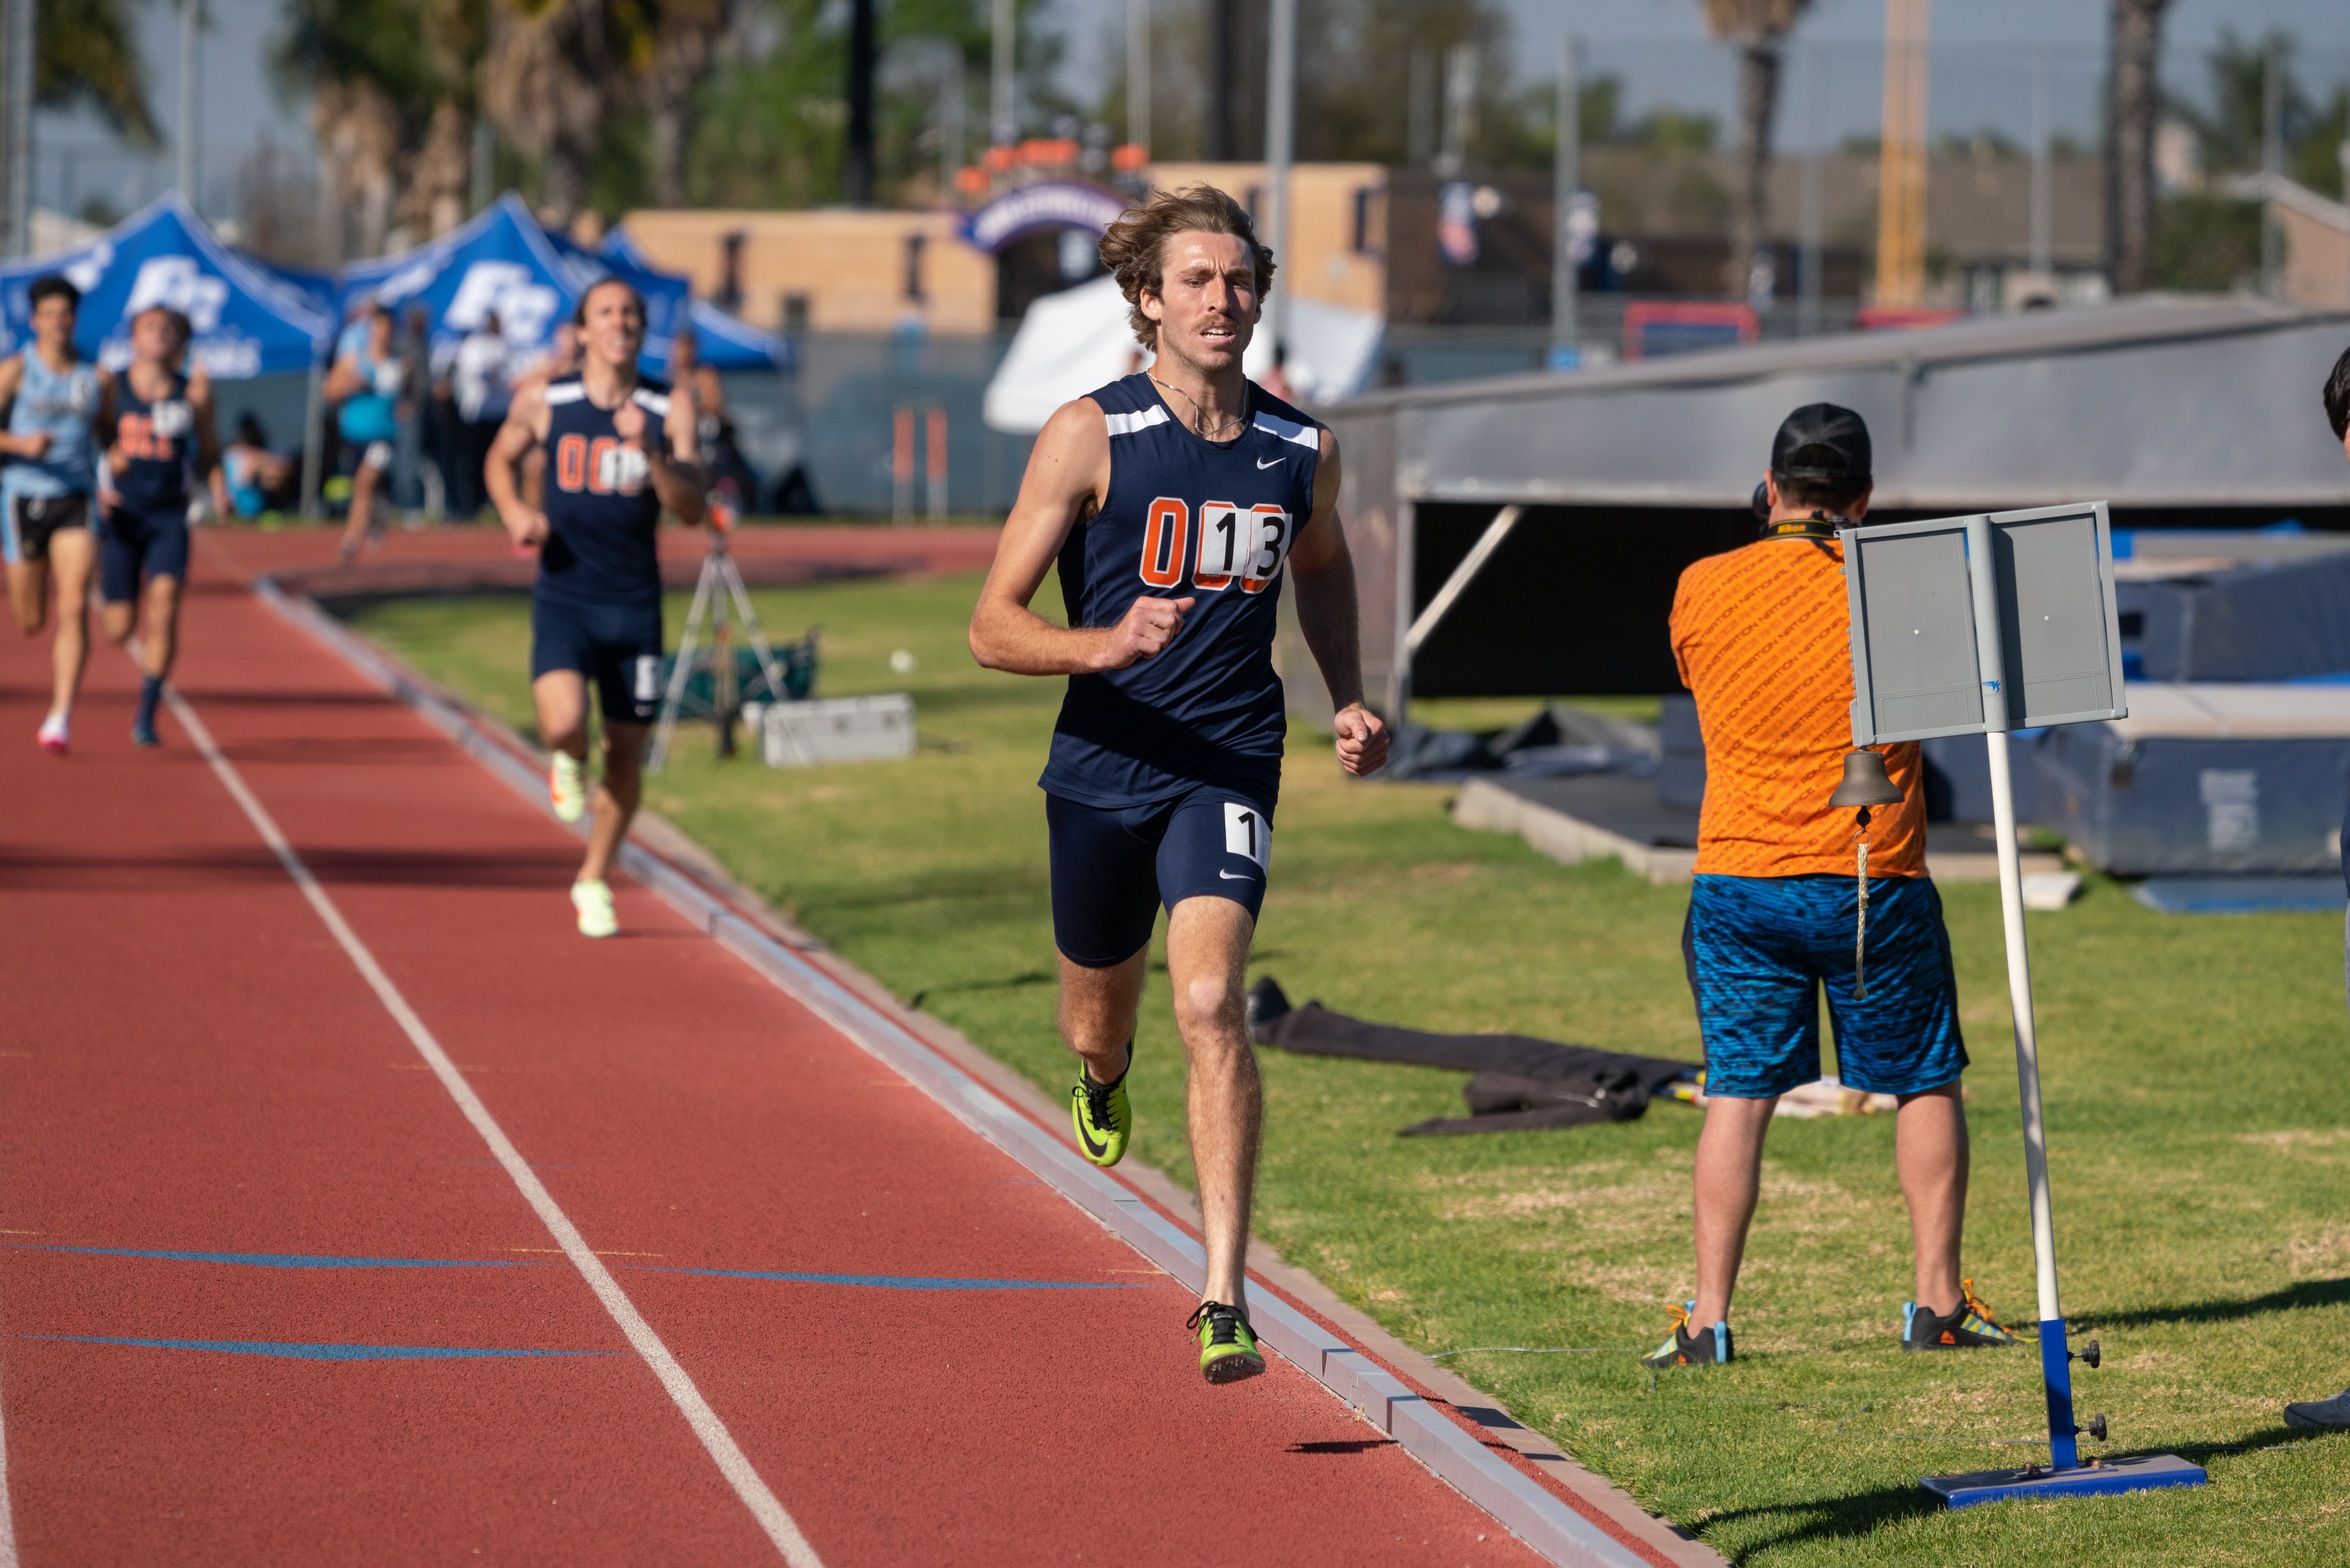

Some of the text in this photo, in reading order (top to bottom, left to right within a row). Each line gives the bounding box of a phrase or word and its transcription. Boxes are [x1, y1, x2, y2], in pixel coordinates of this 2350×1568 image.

[1777, 523, 1807, 535] Nikon
[1738, 569, 1791, 606] NATIONAL
[1757, 586, 1809, 623] NATIONAL
[1711, 639, 1778, 703] ADMINISTRATION
[1777, 601, 1829, 640] NATIONAL
[1725, 655, 1800, 722] ADMINISTRATION
[1798, 616, 1849, 656] NATIONAL
[1743, 672, 1820, 739] ADMINISTRATION
[1780, 787, 1816, 817] SPACE
[1237, 811, 1256, 859] 1
